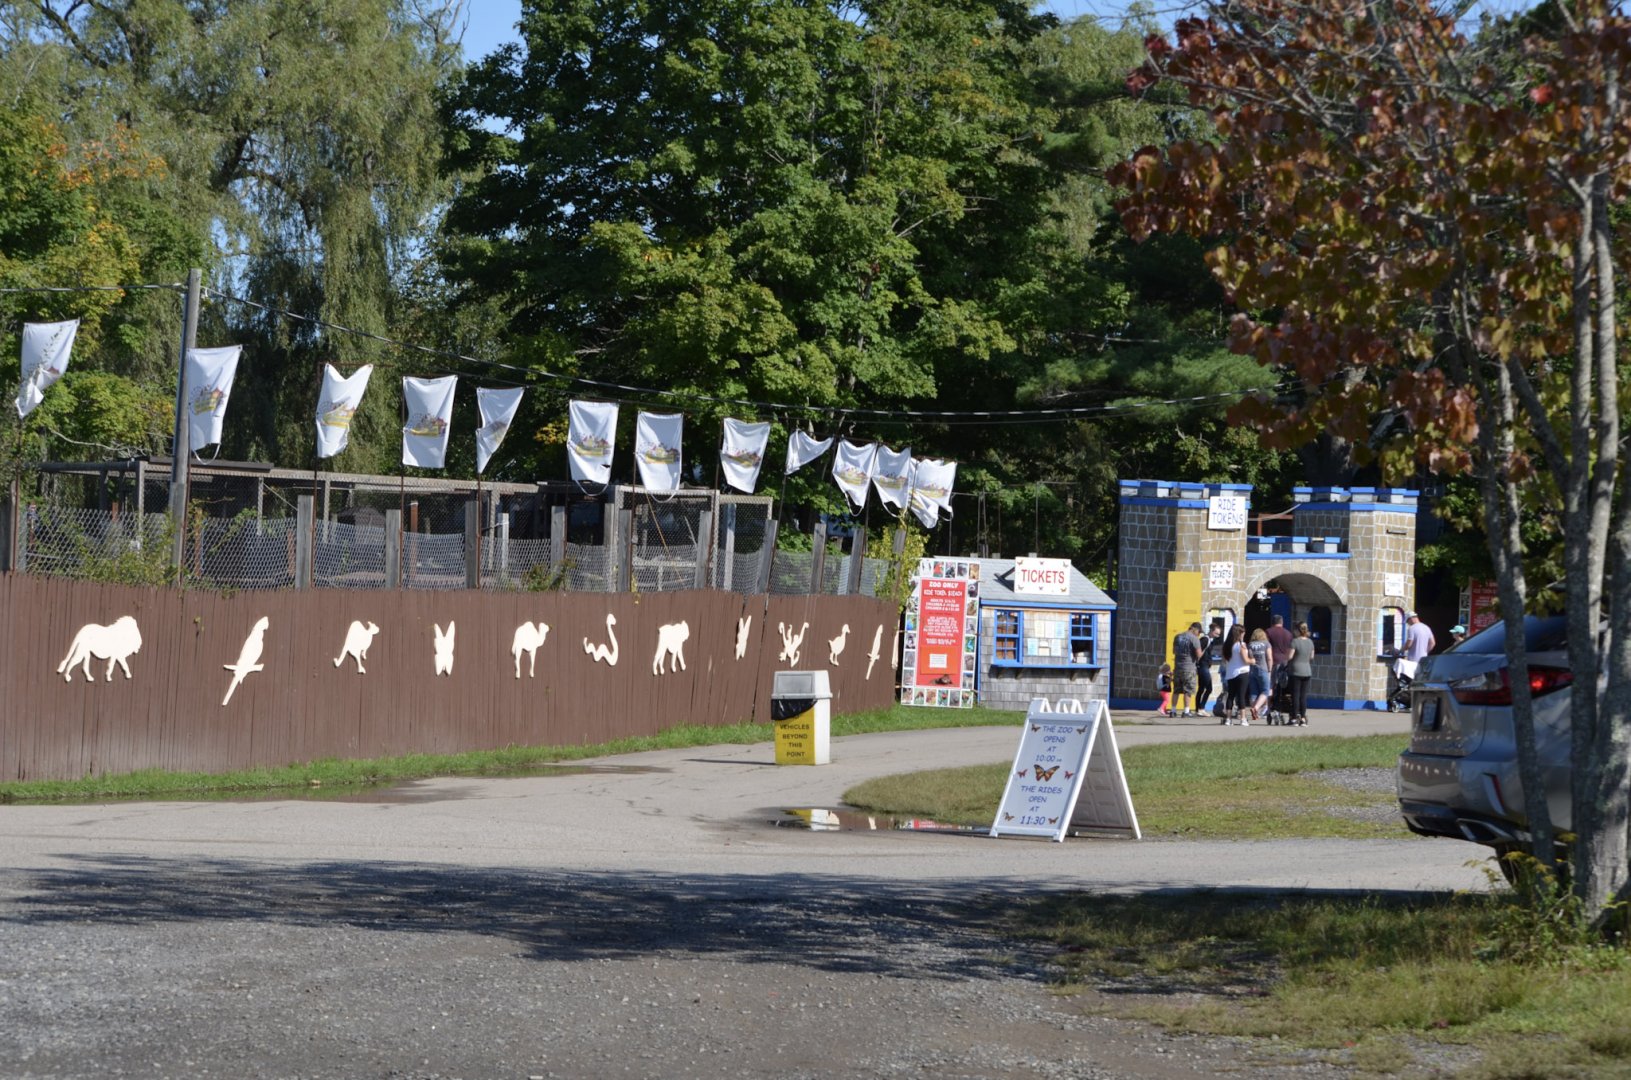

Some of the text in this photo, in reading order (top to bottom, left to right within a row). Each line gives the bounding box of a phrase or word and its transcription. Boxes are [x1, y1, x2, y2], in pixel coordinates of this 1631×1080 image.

[1218, 499, 1236, 511] RIDE
[1212, 512, 1244, 525] TOKENS
[1021, 569, 1065, 584] TICKETS
[1212, 570, 1232, 579] TICKETS
[1043, 735, 1066, 743] OPENS
[1038, 786, 1062, 794] RIDES
[1020, 816, 1046, 825] 11:30
